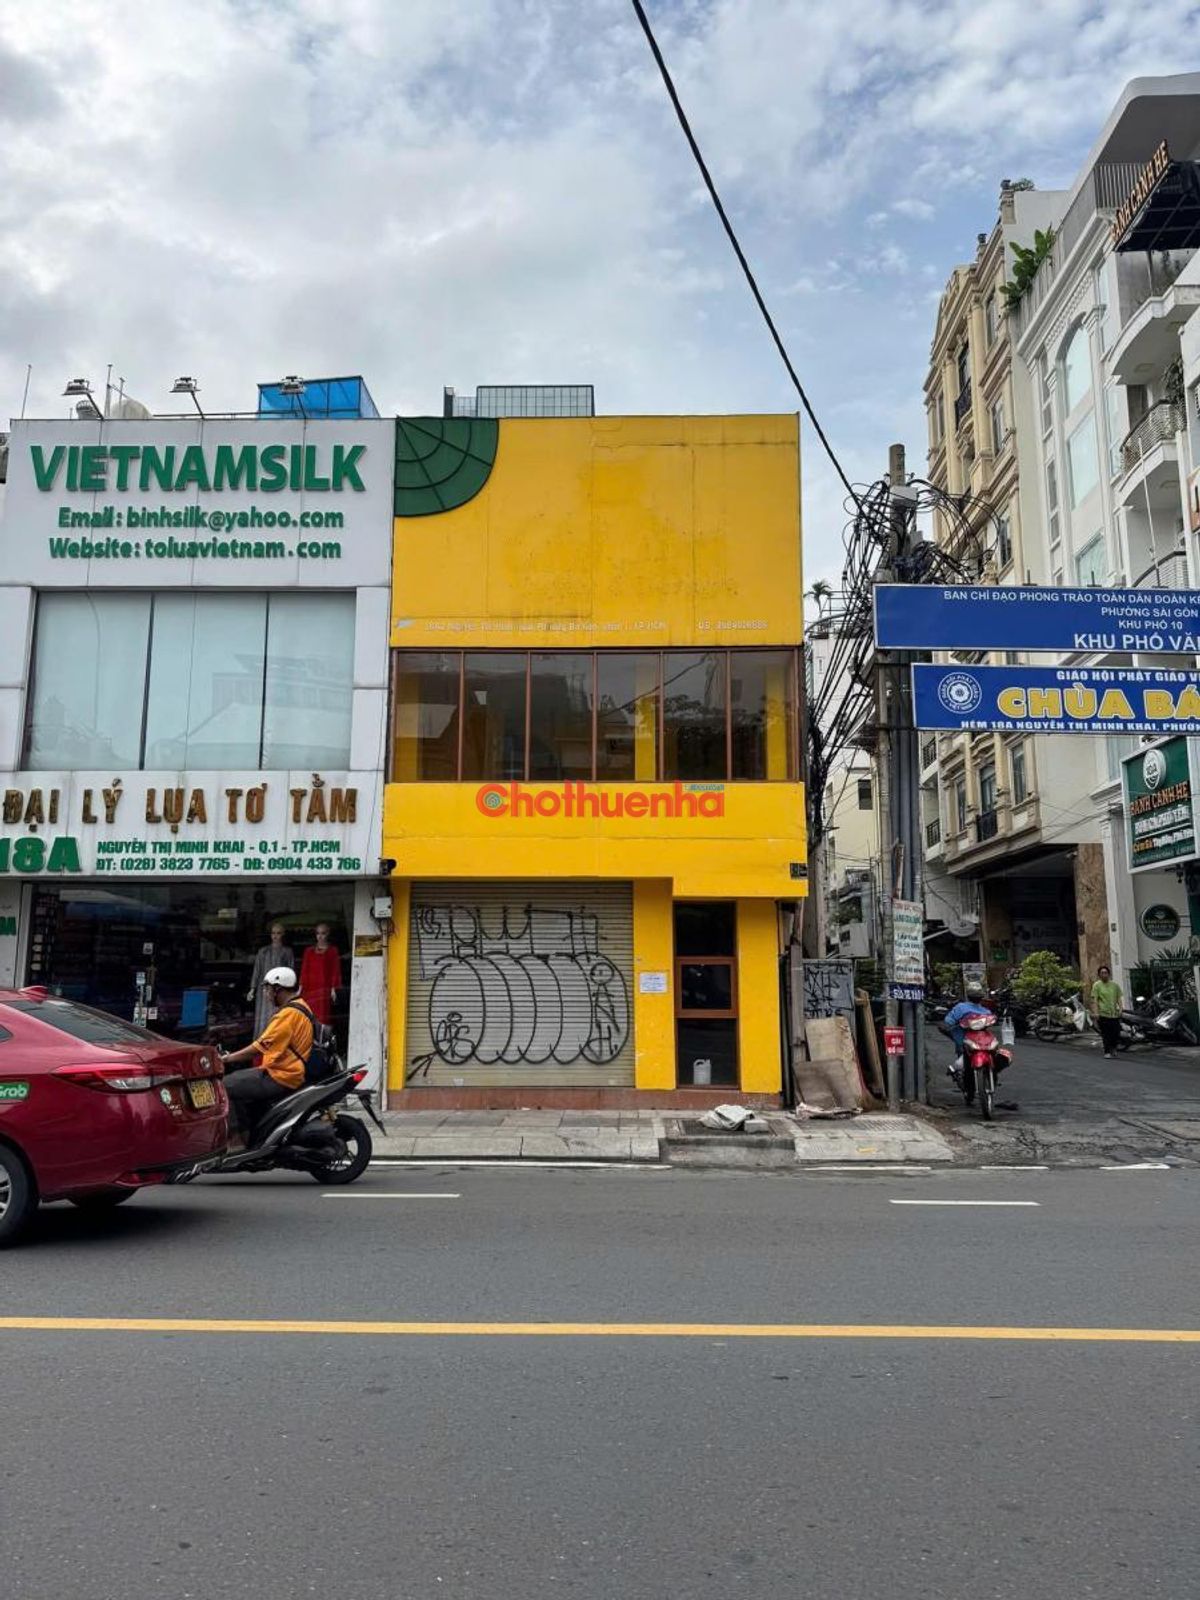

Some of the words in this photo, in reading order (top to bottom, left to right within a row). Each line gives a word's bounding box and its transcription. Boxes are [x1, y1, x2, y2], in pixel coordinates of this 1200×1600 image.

[31, 445, 366, 492] VIETNAMSILK
[59, 507, 122, 528] Email:
[127, 506, 344, 532] binhsilk@yahoo.com
[50, 537, 140, 558] Website:
[145, 537, 341, 558] toluavietnam.com
[944, 590, 968, 600] BAN
[992, 592, 1017, 602] ĐẠO
[1020, 592, 1059, 602] PHONG
[1062, 591, 1093, 603] TRÀO
[1095, 592, 1126, 603] TOÀN
[1154, 593, 1187, 604] ĐOÀN
[1101, 606, 1150, 617] PHƯỜNG
[1153, 607, 1171, 617] SÀI
[1173, 607, 1198, 618] GÒN
[1118, 620, 1141, 630] KHU
[1170, 622, 1183, 631] 10
[1074, 633, 1116, 649] KHU
[1122, 631, 1164, 650] PHỐ
[1056, 670, 1088, 681] GIÁO
[1092, 671, 1114, 682] HỘI
[1118, 671, 1152, 682] PHẬT
[1155, 672, 1186, 682] GIÁO
[997, 682, 1136, 719] CHÙA
[1092, 722, 1124, 731] MINH
[2, 788, 60, 832] ĐẠI
[82, 778, 123, 824] LÝ
[226, 782, 268, 823] TƠ
[0, 837, 81, 872] 18A
[97, 837, 146, 853] NGUYỄN
[150, 841, 172, 856] THỊ
[175, 841, 208, 853] MINH
[213, 841, 245, 853] KHAI
[258, 841, 278, 854] Q.1
[291, 840, 341, 853] TP.HCM
[121, 858, 155, 870] (028)
[160, 858, 193, 870] 3823
[198, 858, 230, 870] 7765
[268, 858, 302, 870] 0904
[306, 858, 332, 870] 433
[337, 858, 361, 870] 766
